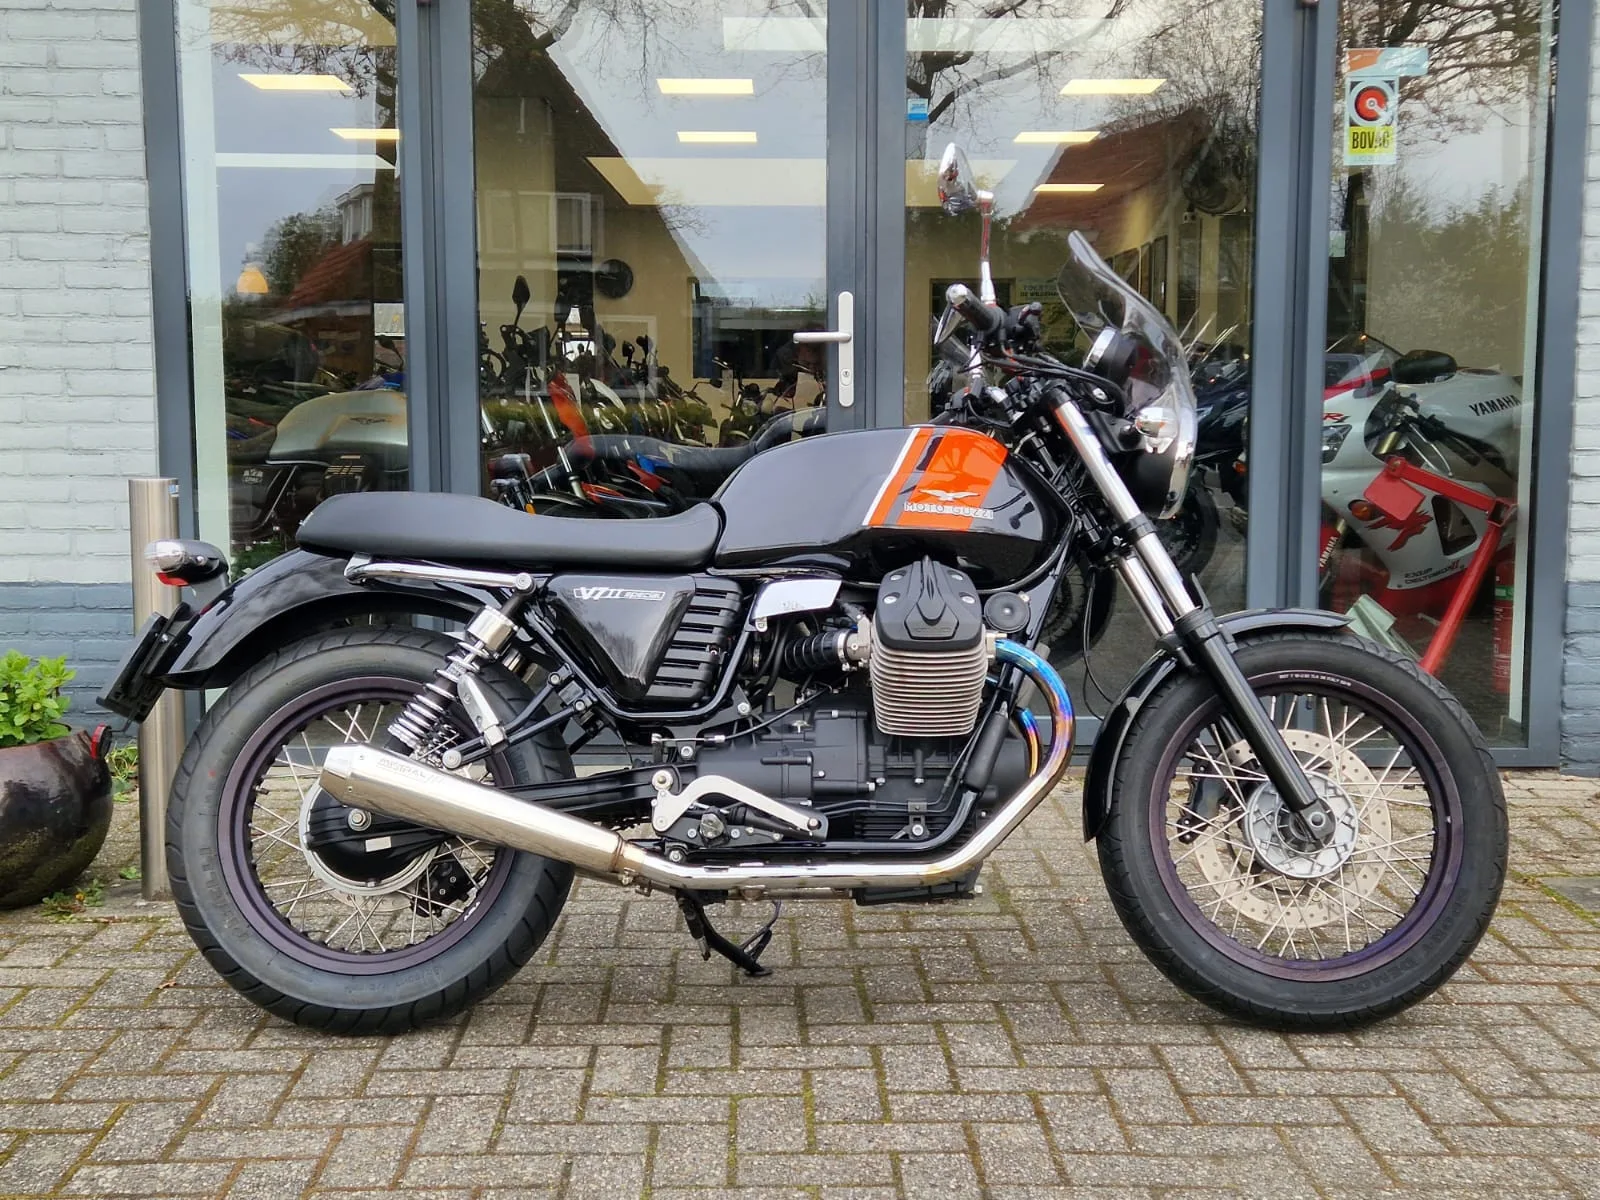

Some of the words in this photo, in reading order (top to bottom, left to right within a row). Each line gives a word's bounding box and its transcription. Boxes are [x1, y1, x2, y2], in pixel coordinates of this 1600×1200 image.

[1468, 394, 1521, 416] YAMAHA
[904, 501, 945, 514] MOTO
[951, 505, 993, 519] GUZZI
